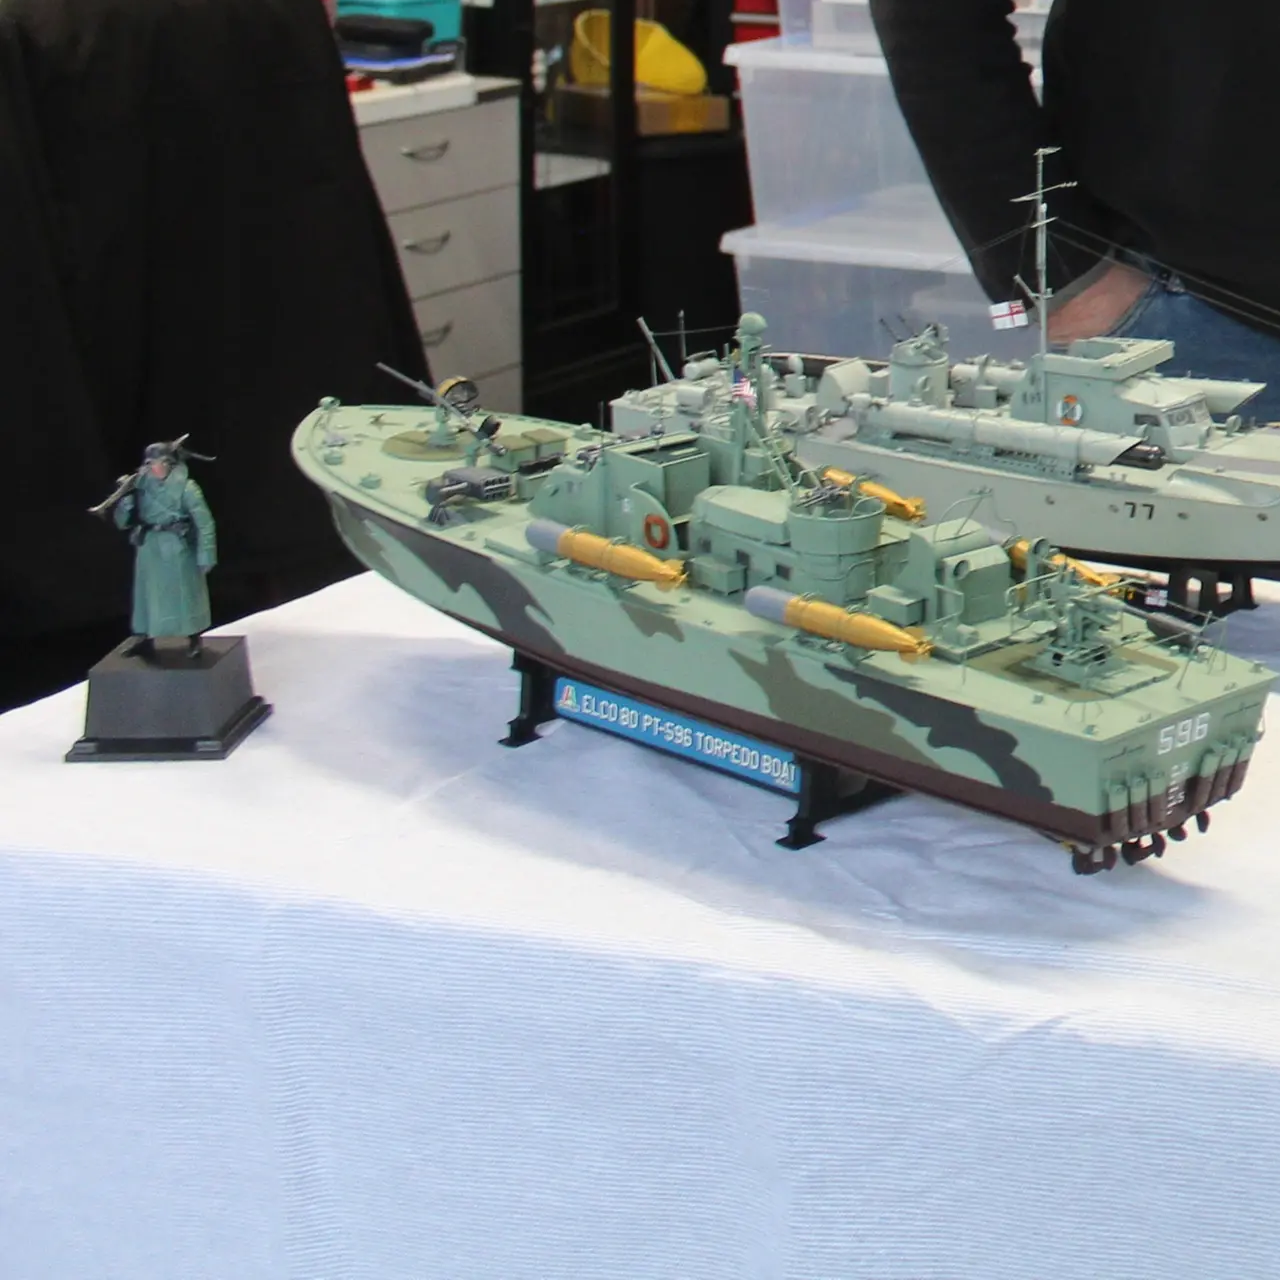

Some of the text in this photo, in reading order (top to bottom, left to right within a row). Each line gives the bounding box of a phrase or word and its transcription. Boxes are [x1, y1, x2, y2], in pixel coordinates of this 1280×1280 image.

[1124, 501, 1155, 520] 77
[581, 694, 618, 723] ELCO
[641, 714, 693, 748] PT-596
[694, 732, 760, 771] TORPEDO
[761, 754, 797, 782] BOAT
[1157, 712, 1212, 756] 596
